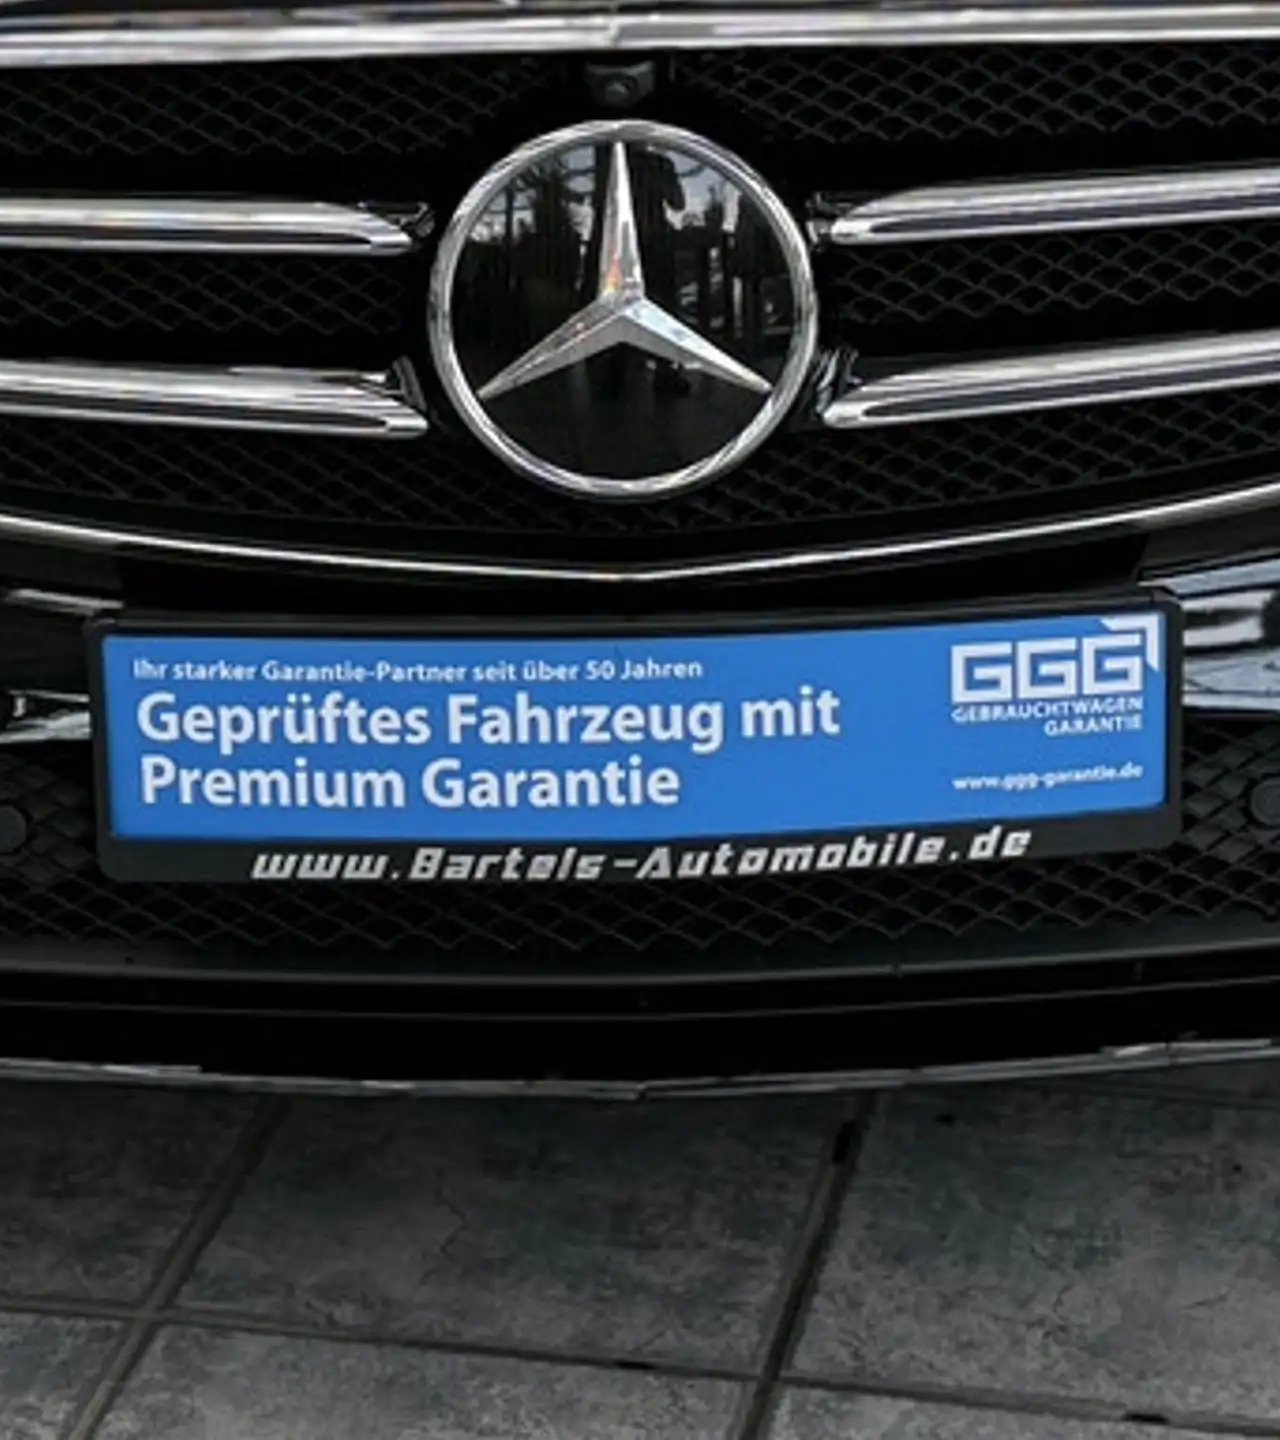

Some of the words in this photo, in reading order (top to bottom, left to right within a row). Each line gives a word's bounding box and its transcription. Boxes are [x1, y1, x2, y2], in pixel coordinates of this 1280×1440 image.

[133, 659, 166, 680] Ihr
[173, 660, 256, 681] starker
[261, 660, 466, 682] Garantie-Partner
[473, 661, 517, 681] seit
[523, 660, 578, 681] über
[584, 660, 615, 680] 50
[620, 658, 703, 679] Jahren
[951, 633, 1143, 703] GGG
[136, 692, 432, 756] Geprüftes
[448, 692, 724, 754] Fahrzeug
[741, 685, 841, 738] mit
[951, 696, 1143, 724] GEBRAUCHTWAGEN
[1044, 713, 1143, 737] GARANTIE
[140, 755, 406, 808] Premium
[422, 753, 680, 808] Garantie
[952, 761, 1143, 791] www.ggg-garantie.de
[251, 825, 1032, 881] www.Bartels-Automobile.de
